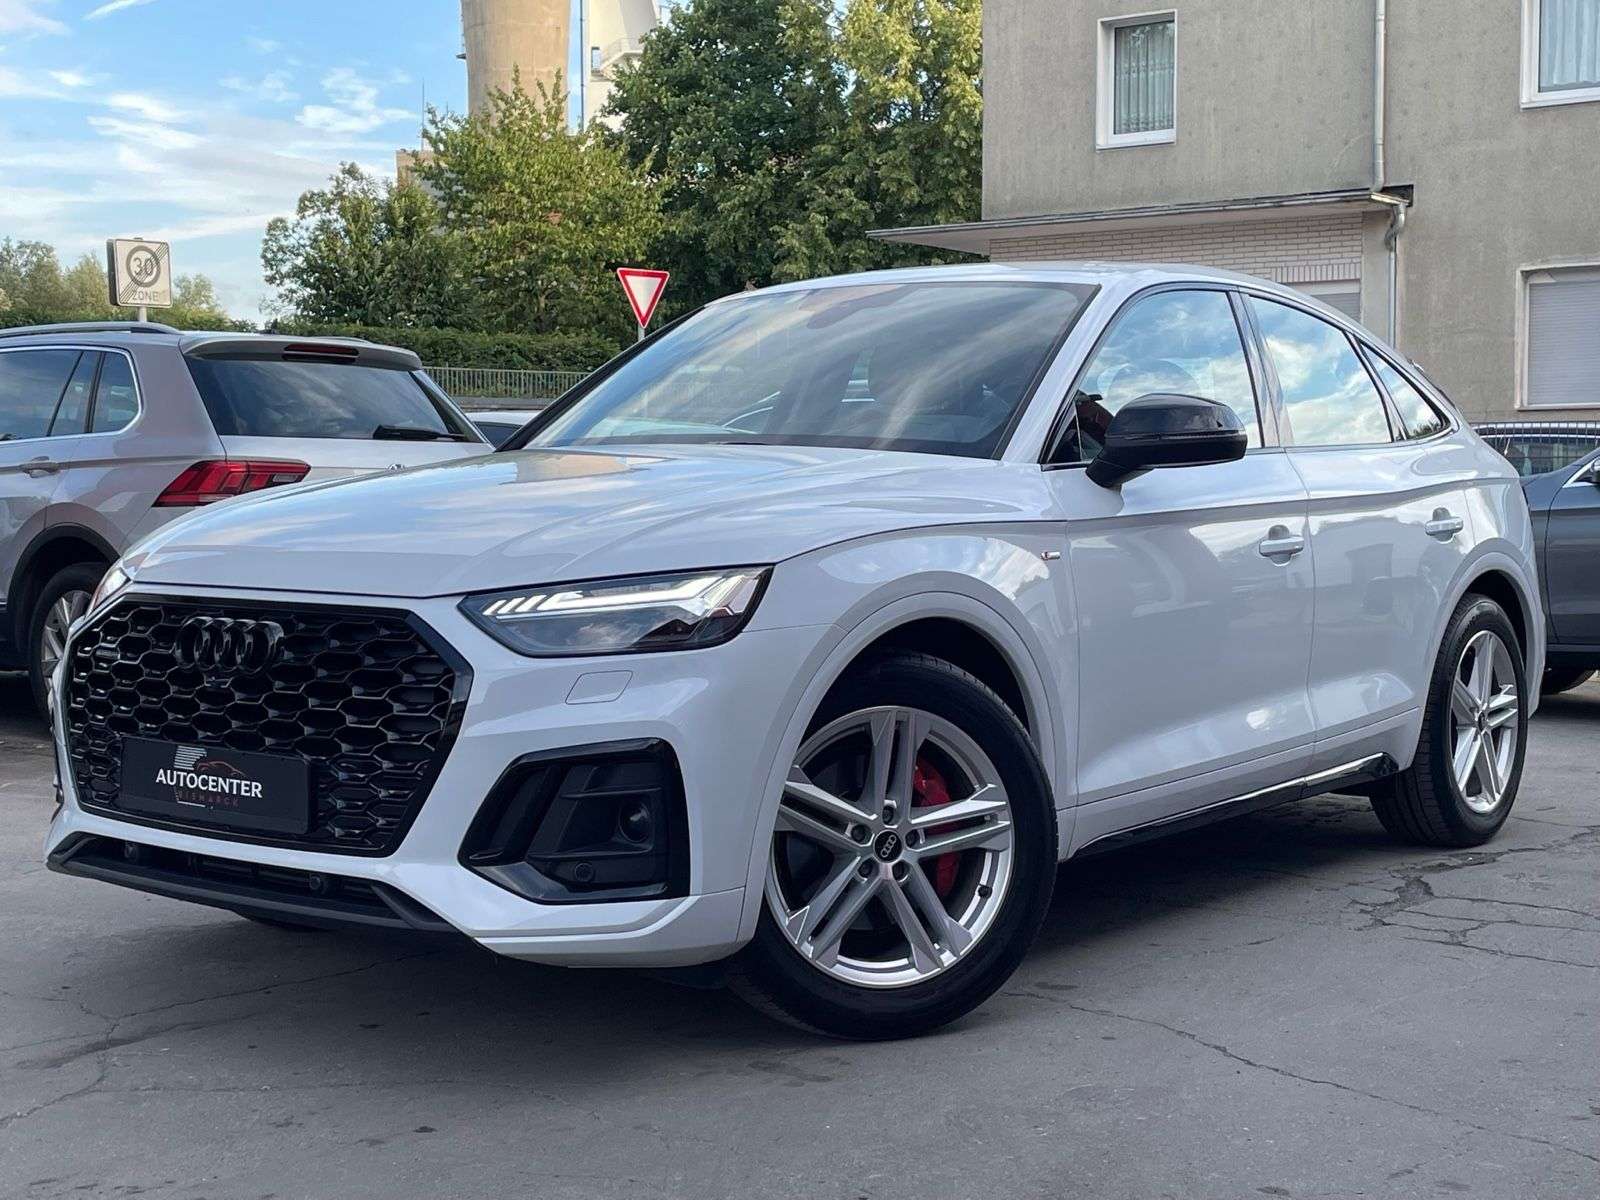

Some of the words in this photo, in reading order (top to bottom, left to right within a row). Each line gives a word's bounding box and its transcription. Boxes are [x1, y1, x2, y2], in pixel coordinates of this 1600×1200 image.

[133, 257, 154, 276] 30
[132, 290, 159, 302] ZONE
[155, 768, 263, 798] AUTOCENTER
